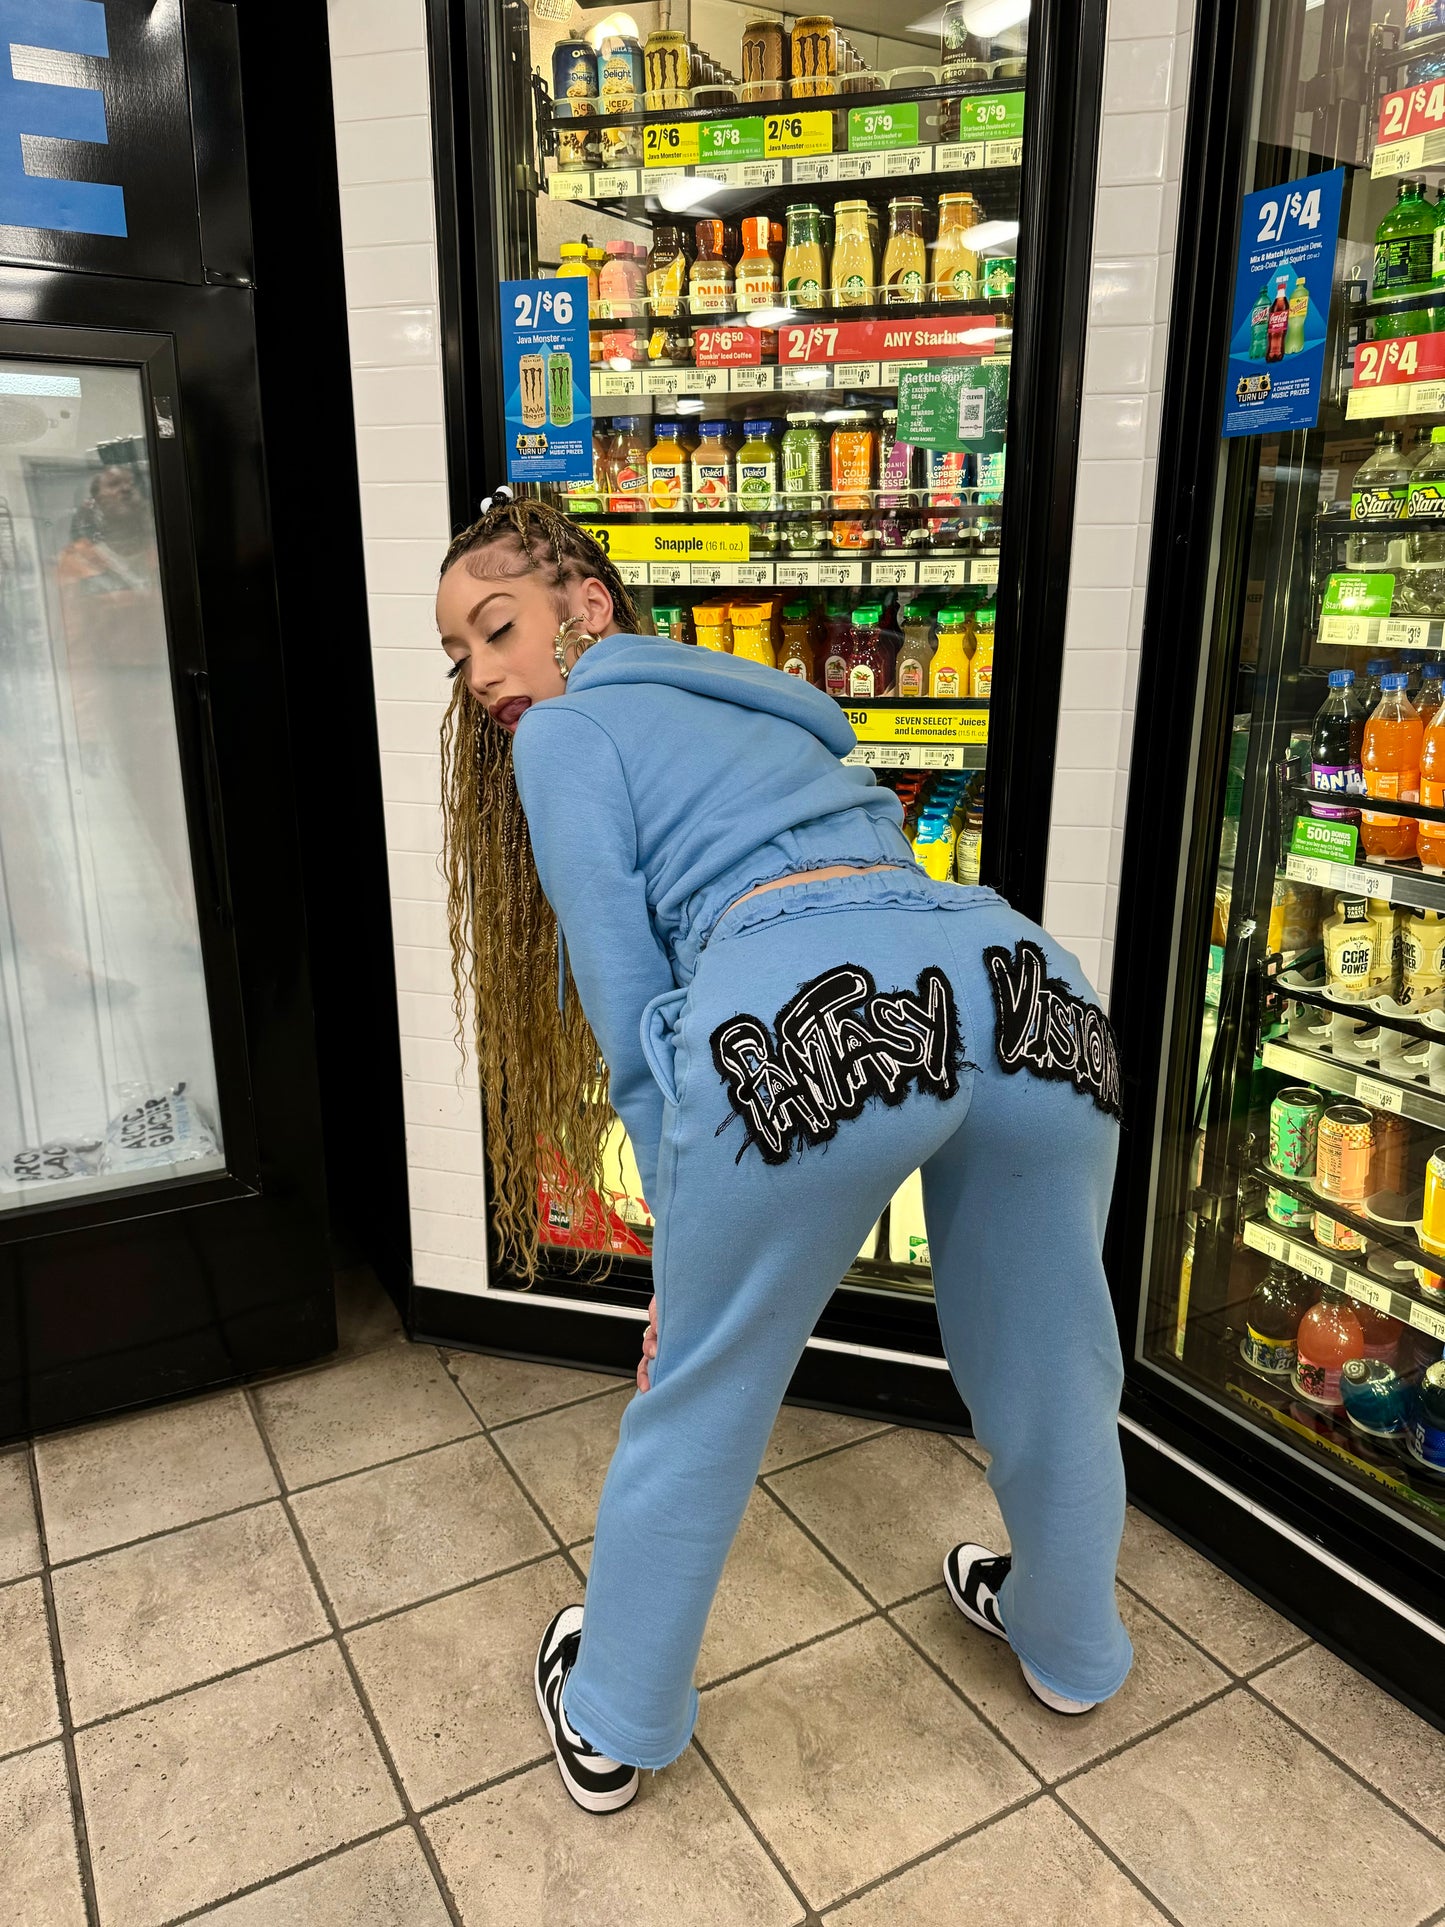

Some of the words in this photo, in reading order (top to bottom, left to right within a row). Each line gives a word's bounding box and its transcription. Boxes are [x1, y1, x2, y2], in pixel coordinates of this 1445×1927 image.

[603, 69, 631, 80] Delight
[608, 100, 628, 108] ICED
[1384, 83, 1445, 136] 2/$4
[976, 105, 1006, 124] 3/$9
[768, 118, 802, 142] 2/$6
[864, 115, 893, 135] 3/$9
[647, 128, 680, 151] 2/$6
[713, 128, 740, 148] 3/$8
[702, 150, 713, 158] Java
[713, 148, 733, 157] Monster
[768, 144, 781, 152] Java
[782, 142, 804, 151] Monster
[661, 151, 682, 159] Monster
[963, 150, 976, 168] $479
[816, 163, 829, 181] $419
[859, 160, 872, 177] $479
[907, 156, 921, 173] $479
[763, 169, 775, 185] $419
[1257, 189, 1321, 243] 2/$4
[1250, 256, 1261, 265] Mix
[1266, 250, 1284, 260] Match
[1284, 244, 1310, 255] Mountain
[1279, 258, 1289, 266] and
[1289, 254, 1306, 264] Squirt
[514, 290, 573, 328] 2/$6
[516, 334, 532, 345] Java
[533, 334, 560, 343] Monster
[788, 327, 839, 361] 2/$7
[884, 331, 912, 348] ANY
[733, 351, 752, 359] Coffee
[1359, 341, 1418, 383] 2/$4
[857, 370, 870, 385] $479
[904, 372, 922, 383] Get
[923, 371, 941, 382] the
[1238, 391, 1258, 402] TURN
[1258, 391, 1268, 400] UP
[1271, 391, 1289, 399] MUSIC
[1289, 388, 1310, 397] PRIZES
[653, 468, 675, 478] Naked
[701, 468, 723, 478] Naked
[743, 468, 765, 478] Naked
[844, 470, 867, 478] COLD
[1355, 493, 1404, 519] Starry
[654, 536, 703, 552] Snapple
[705, 540, 718, 551] (16
[719, 540, 728, 551] fl.
[729, 540, 744, 551] oz.)
[1338, 586, 1367, 599] FREE
[895, 716, 922, 726] SEVEN
[959, 718, 987, 727] Juices
[894, 727, 910, 736] and
[911, 727, 957, 737] Lemonades
[864, 750, 876, 765] $279
[899, 751, 910, 766] $279
[943, 753, 955, 767] $279
[1306, 826, 1331, 842] 500
[1331, 830, 1351, 839] BONUS
[1330, 837, 1351, 847] POINTS
[1342, 948, 1370, 963] CORE
[1341, 962, 1368, 975] POWER
[718, 968, 952, 1155] FANTASY
